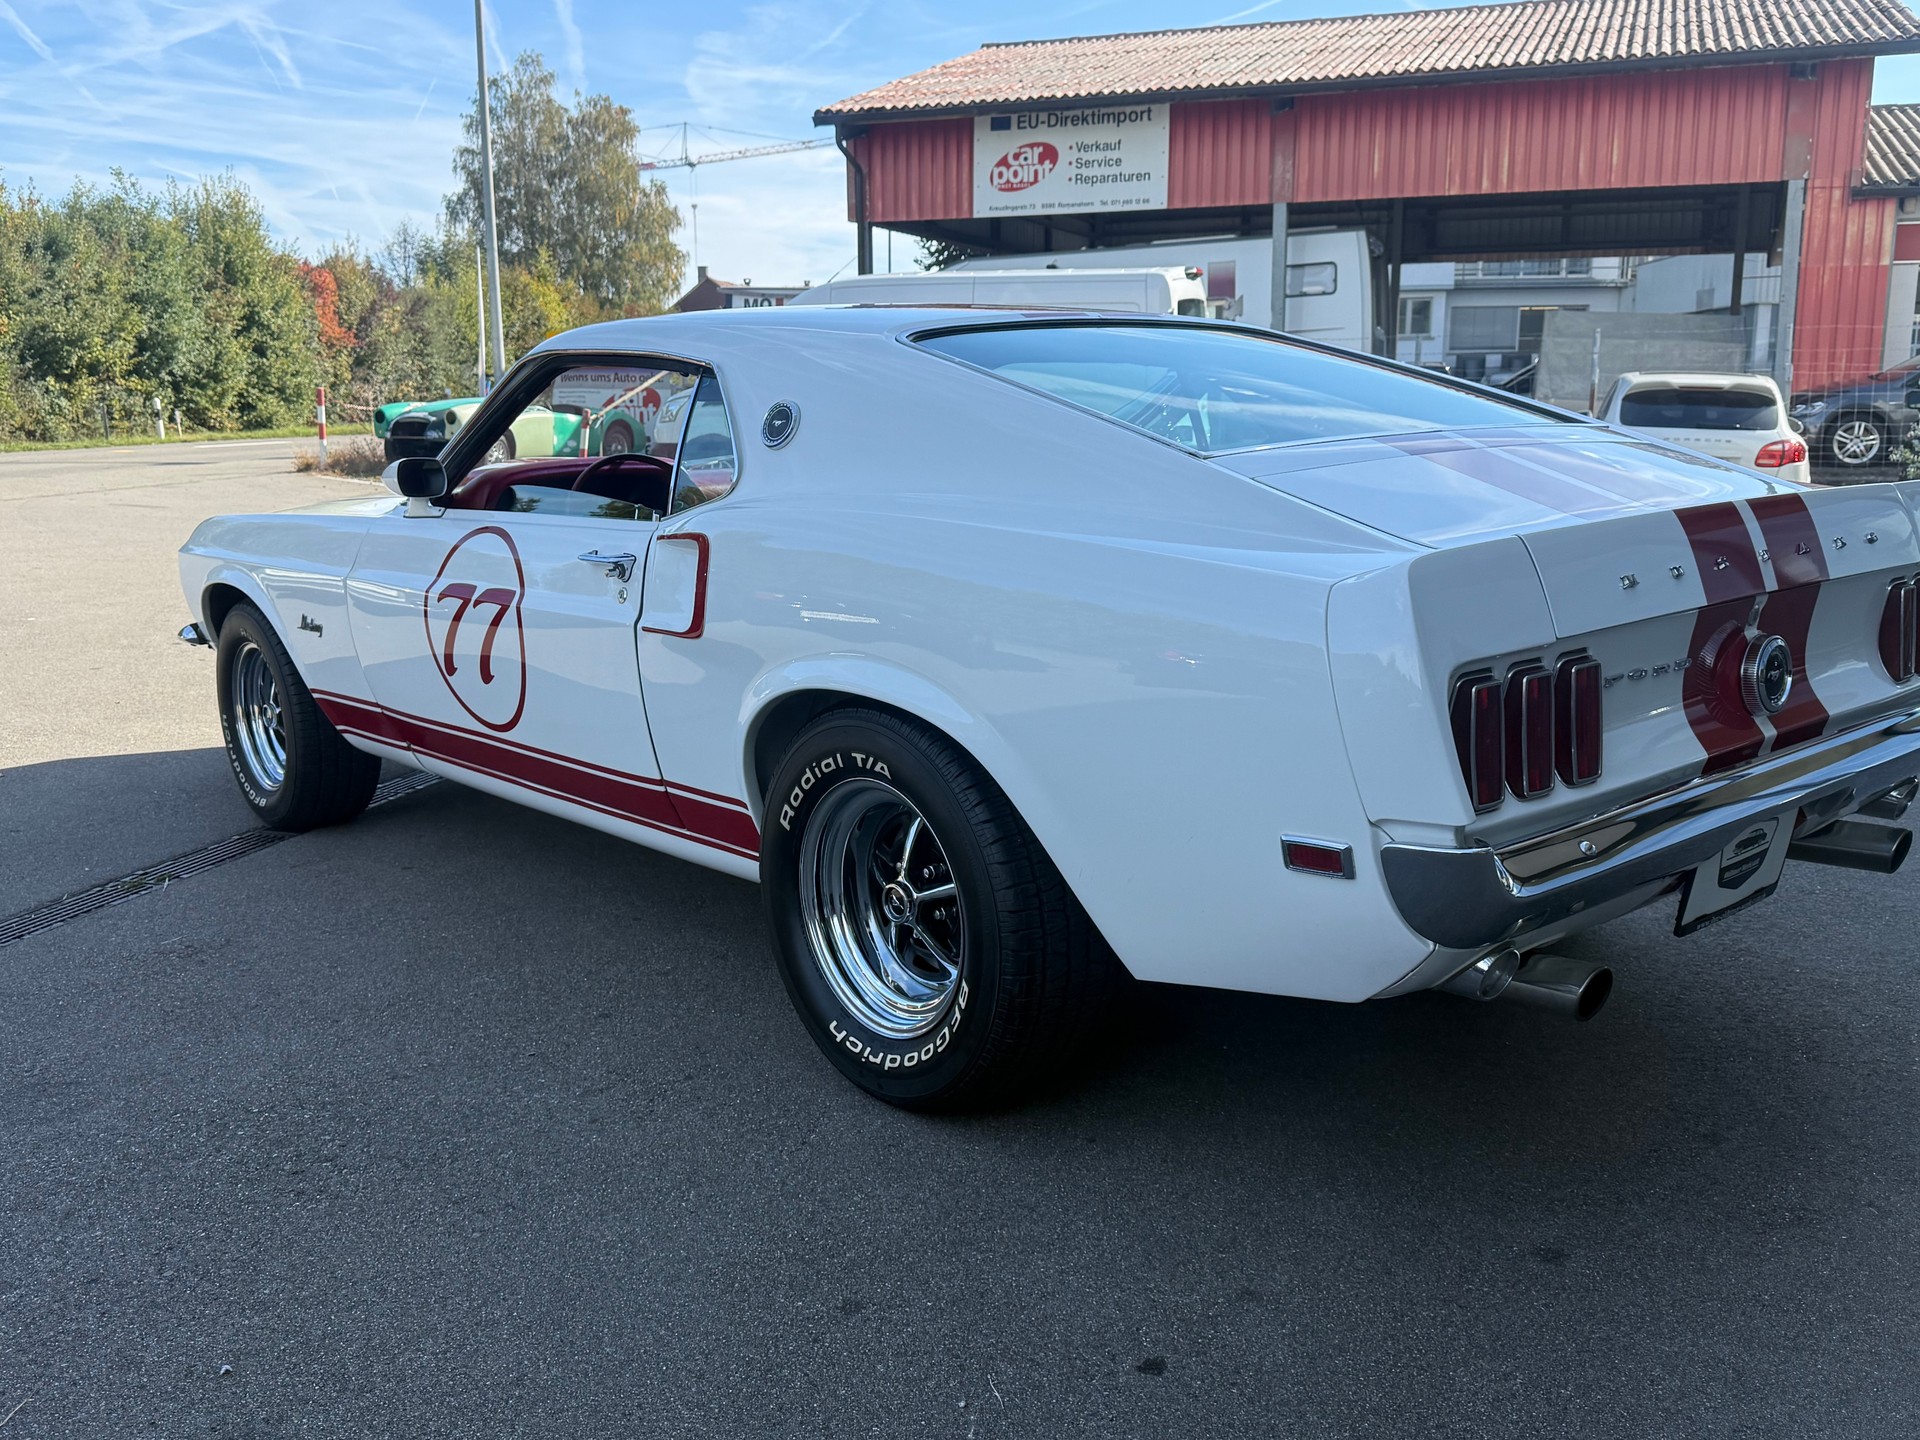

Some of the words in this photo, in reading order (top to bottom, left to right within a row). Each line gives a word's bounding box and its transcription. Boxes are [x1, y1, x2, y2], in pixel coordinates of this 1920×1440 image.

[1016, 107, 1152, 130] EU-Direktimport
[1007, 145, 1044, 166] car
[1075, 139, 1122, 153] Verkauf
[993, 159, 1054, 187] point
[1075, 157, 1122, 169] Service
[1074, 171, 1151, 187] Reparaturen
[561, 373, 589, 383] Wenns
[590, 373, 611, 383] ums
[613, 372, 637, 383] Auto
[1618, 531, 1879, 591] MUSTANG
[437, 582, 517, 685] 77
[1603, 657, 1692, 689] FORD
[222, 714, 267, 807] BFGoodrich
[779, 753, 844, 832] Radial
[851, 752, 892, 780] T/A
[828, 978, 969, 1071] BFGoodrich
